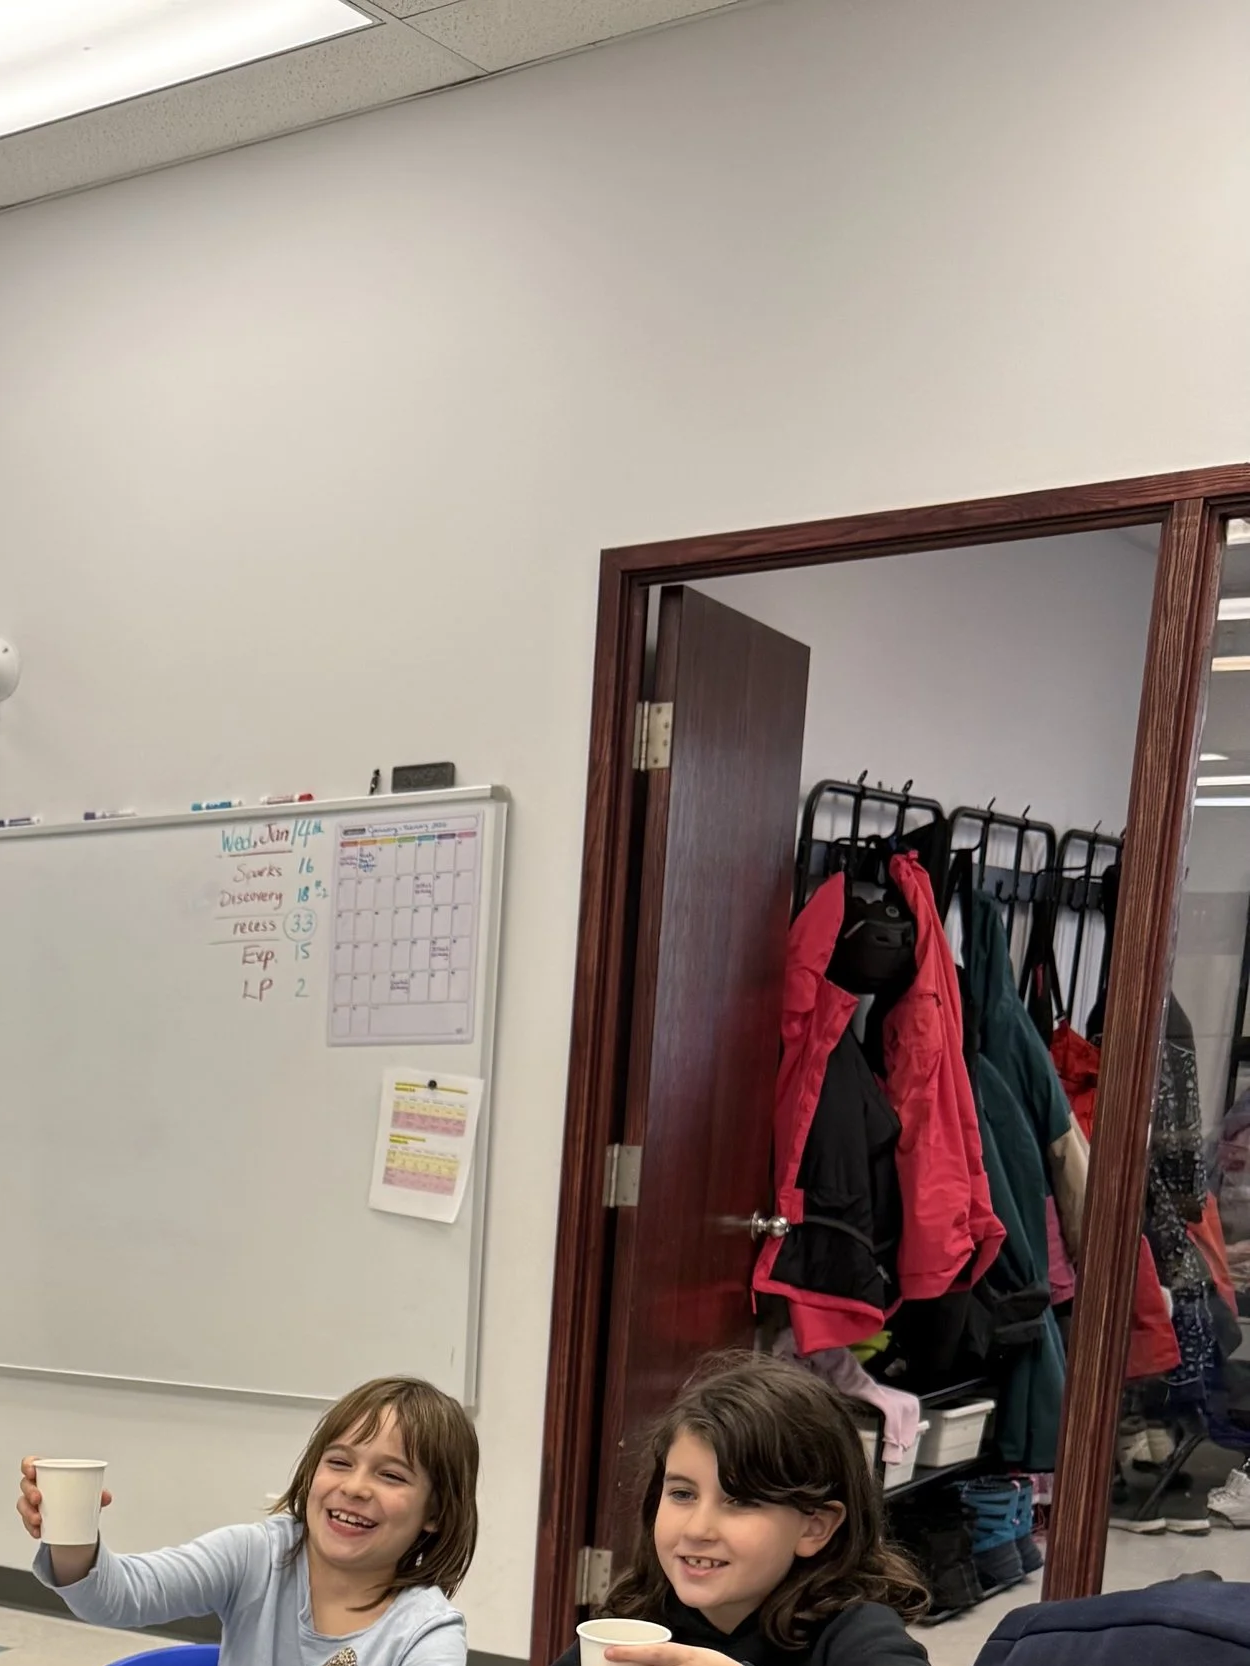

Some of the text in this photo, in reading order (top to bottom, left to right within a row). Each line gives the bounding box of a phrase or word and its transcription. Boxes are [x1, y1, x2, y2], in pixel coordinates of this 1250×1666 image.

[298, 857, 314, 874] 16
[220, 890, 283, 909] Discovery
[233, 913, 313, 935] recess 33
[295, 942, 312, 961] 15
[242, 978, 309, 1002] LP 2
